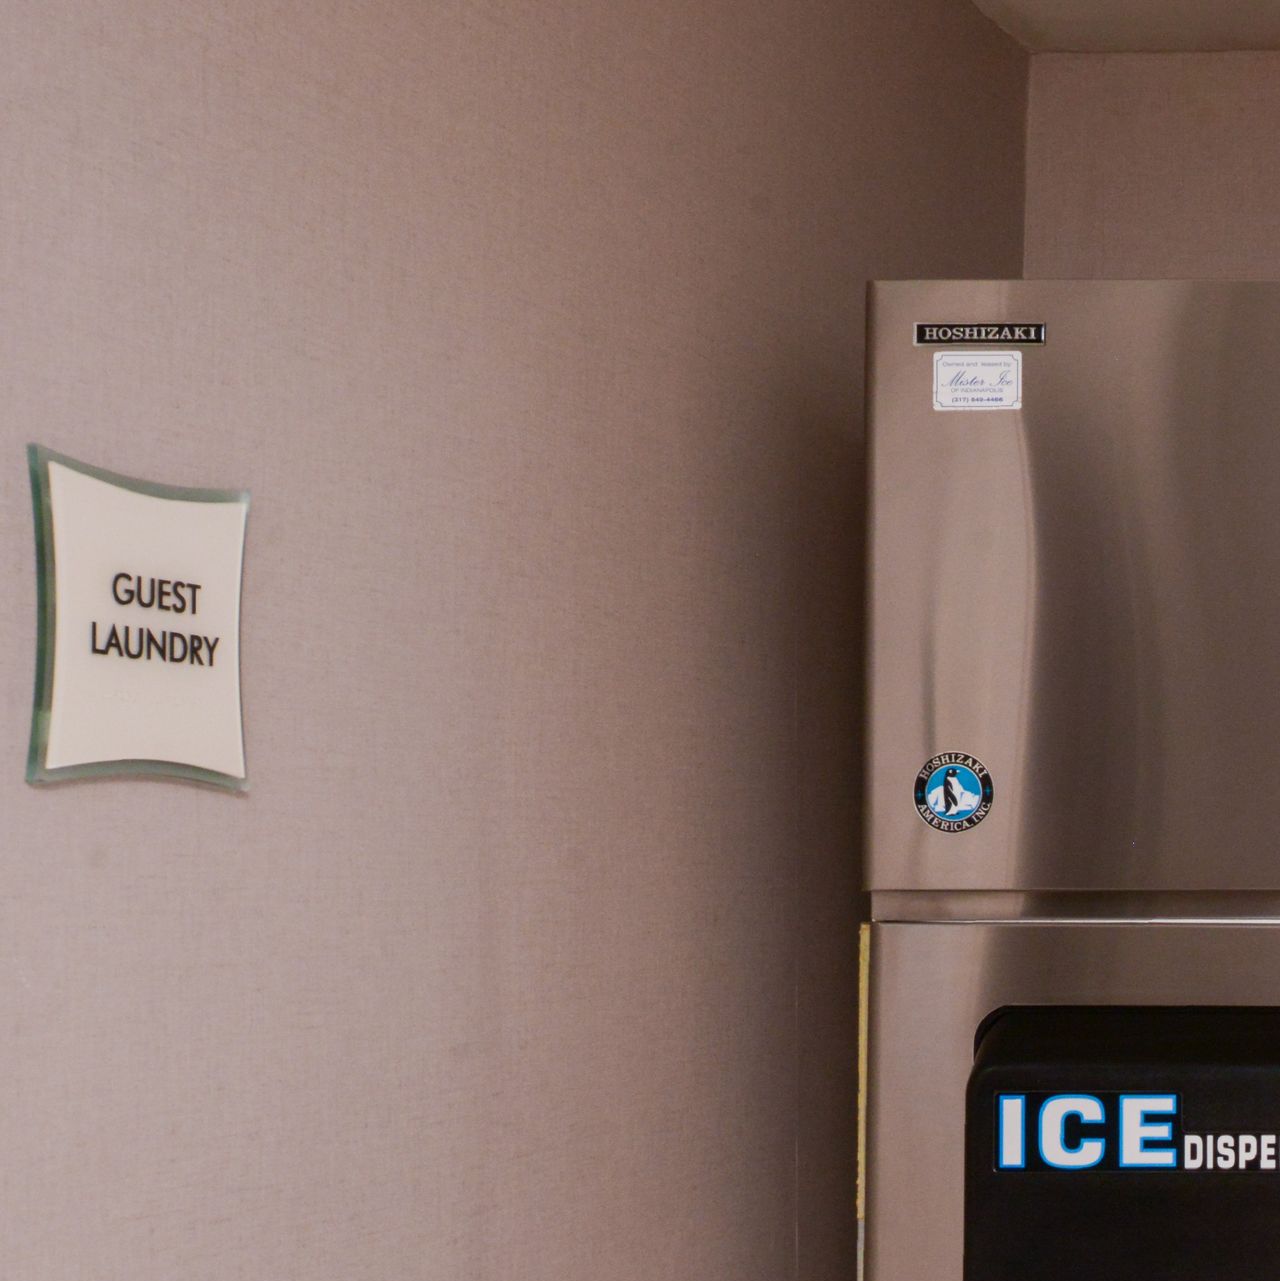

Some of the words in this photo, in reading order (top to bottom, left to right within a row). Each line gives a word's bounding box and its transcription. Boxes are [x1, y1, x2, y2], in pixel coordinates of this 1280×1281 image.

[924, 327, 1037, 340] HOSHIZAKI
[941, 370, 985, 387] Mister
[989, 370, 1013, 387] Ice
[112, 572, 202, 615] GUEST
[91, 621, 220, 667] LAUNDRY
[919, 753, 988, 780] HOSHIZAKI
[998, 1093, 1179, 1170] ICE
